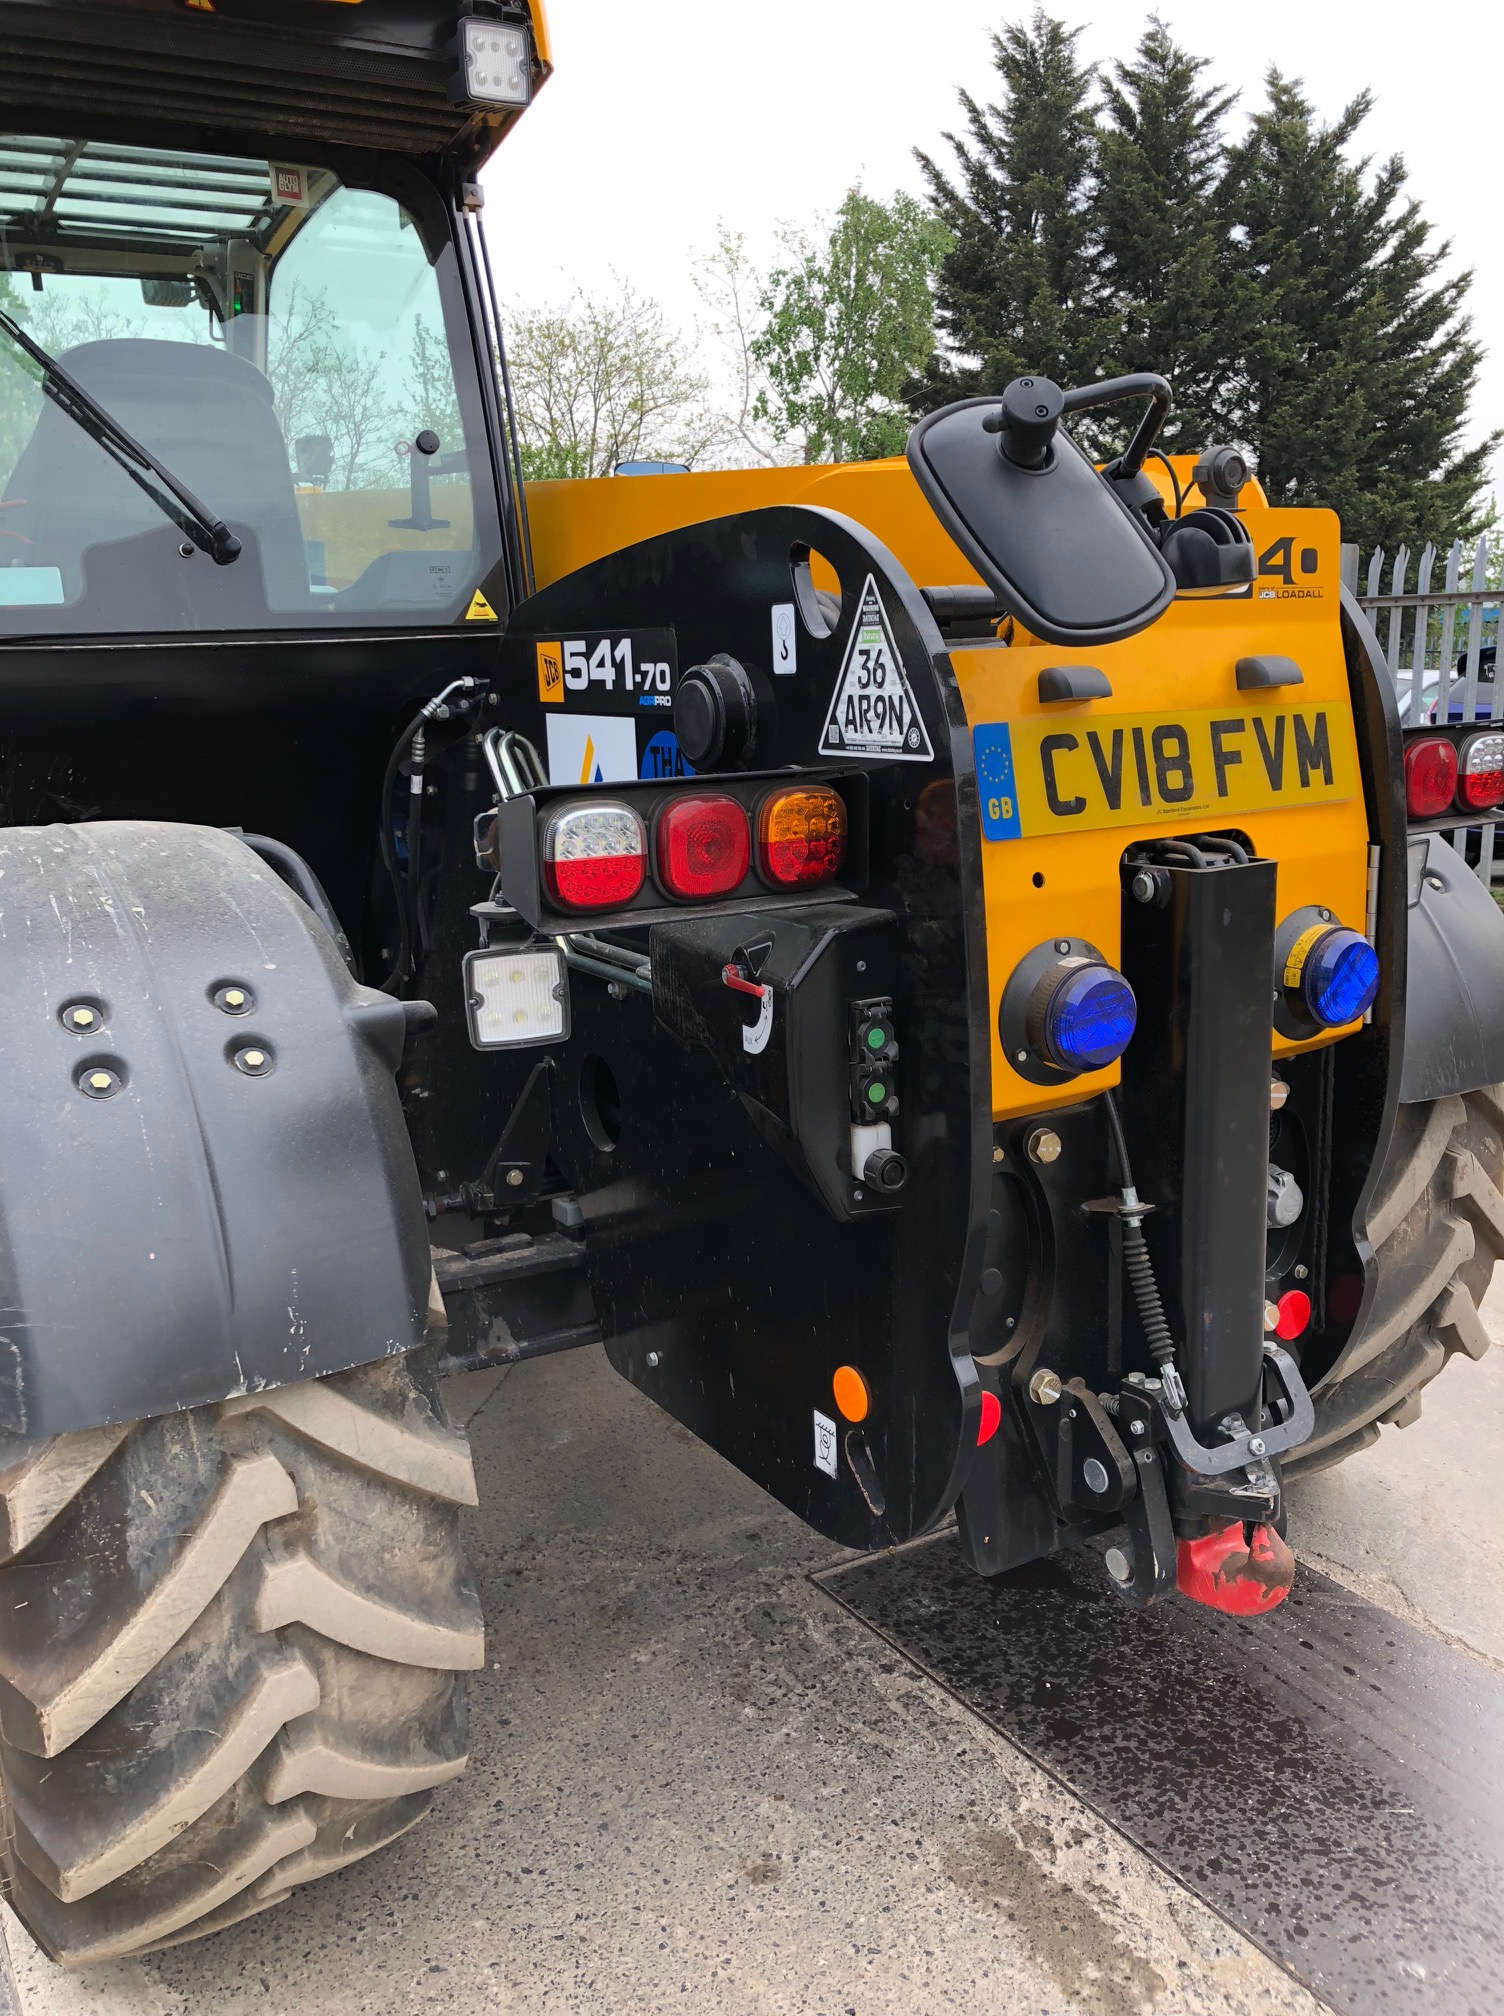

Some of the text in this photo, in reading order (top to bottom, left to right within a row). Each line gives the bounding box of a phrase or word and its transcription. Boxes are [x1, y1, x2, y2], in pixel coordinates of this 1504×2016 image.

[278, 173, 299, 184] AUTO
[279, 182, 300, 193] GLYM
[1258, 536, 1318, 586] 40
[1258, 590, 1324, 599] JCB LOADALL
[543, 658, 561, 687] JCB
[858, 648, 887, 690] 36
[844, 694, 904, 736] AR9N
[1040, 711, 1335, 817] CV18 FVM
[988, 796, 1013, 820] GB
